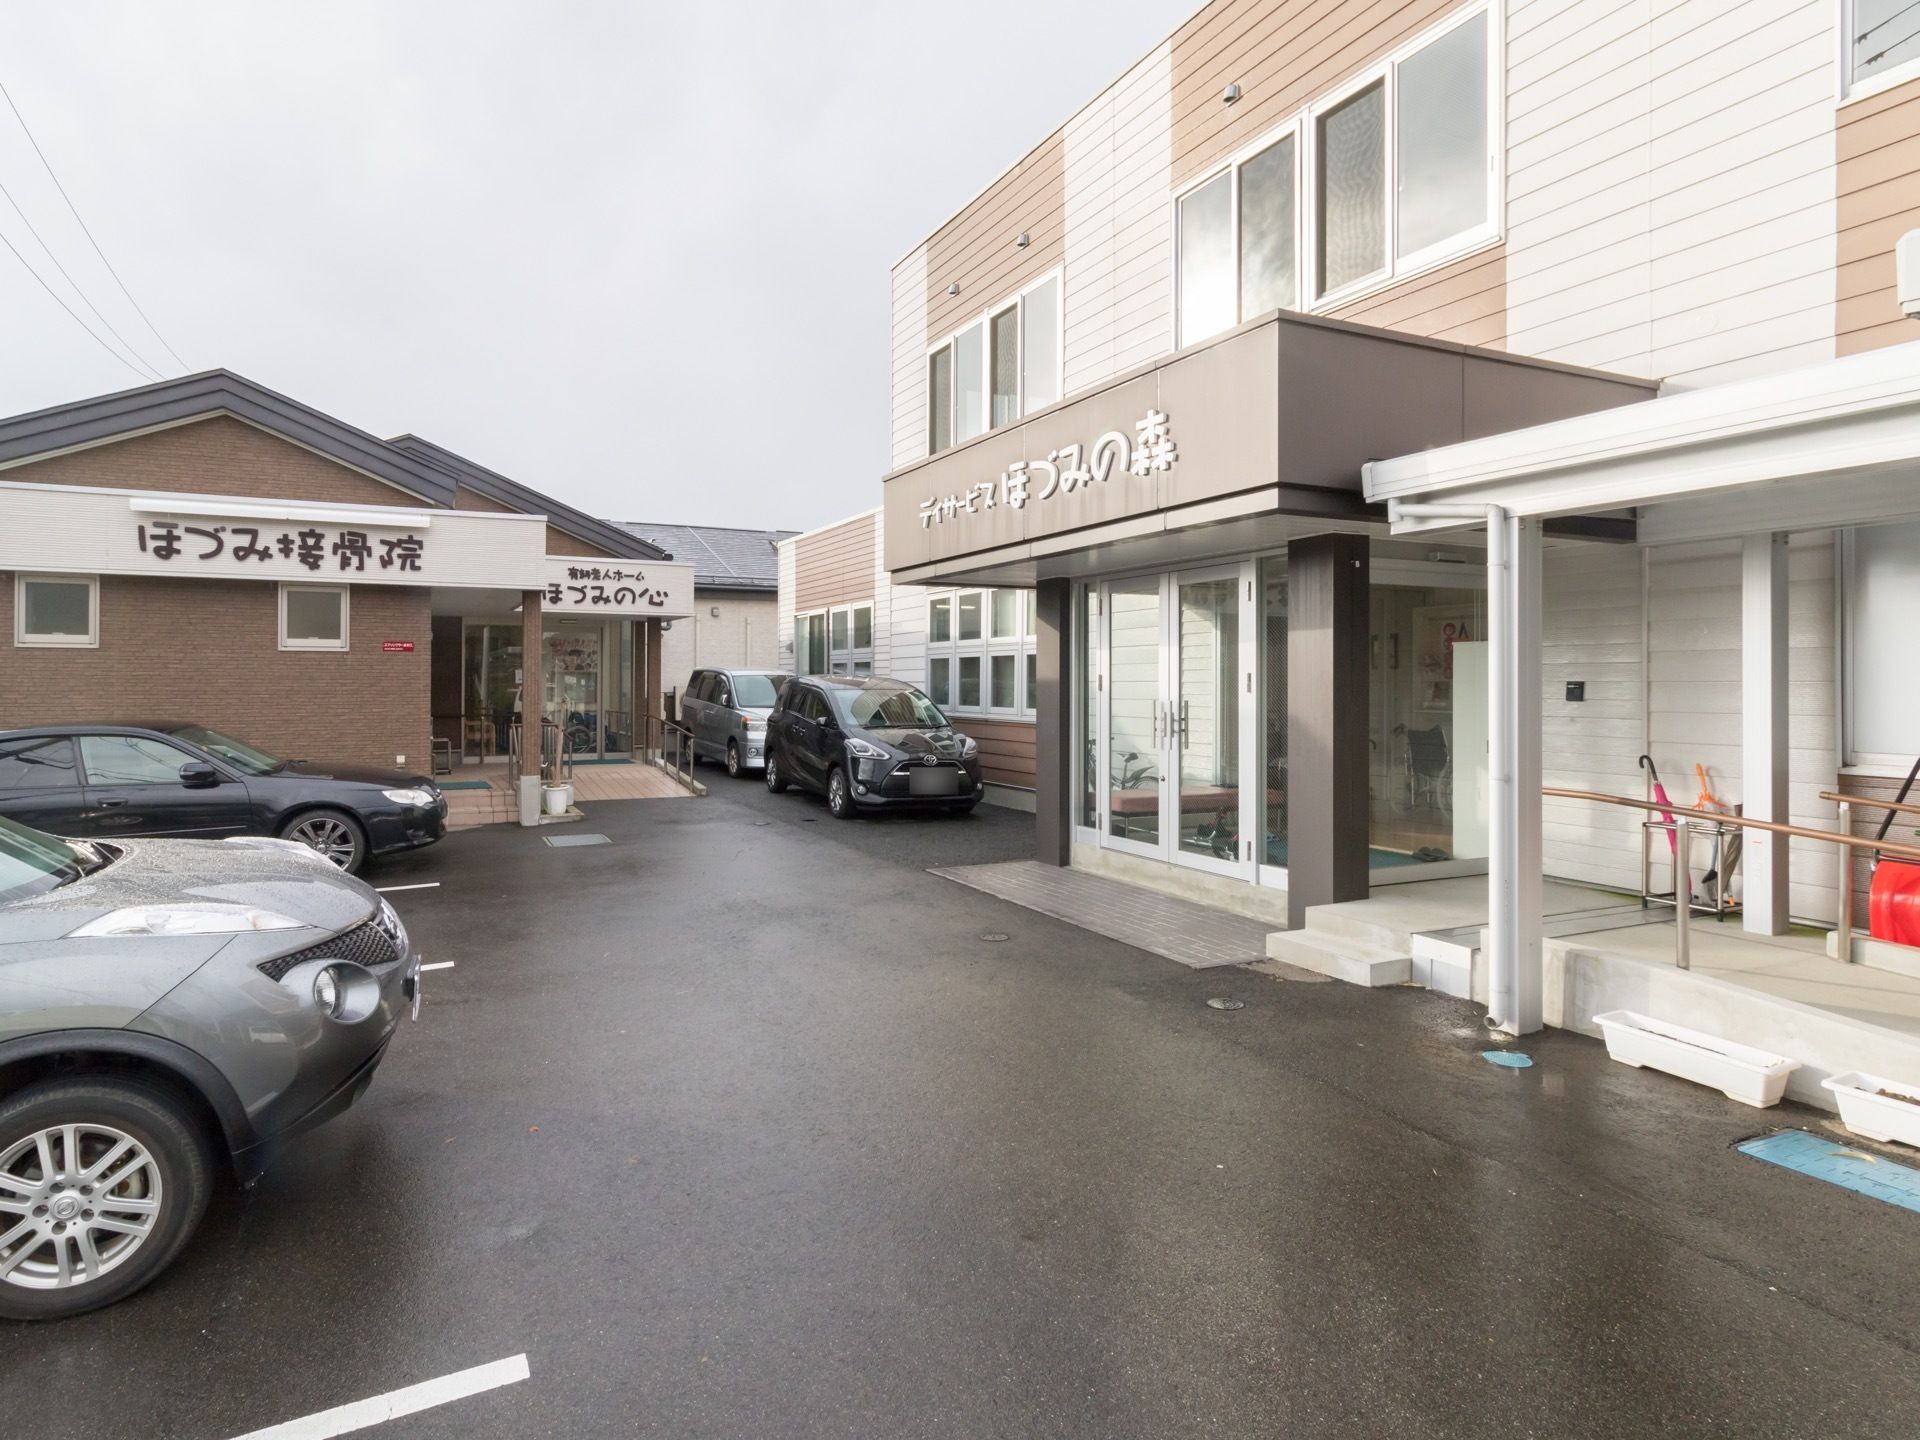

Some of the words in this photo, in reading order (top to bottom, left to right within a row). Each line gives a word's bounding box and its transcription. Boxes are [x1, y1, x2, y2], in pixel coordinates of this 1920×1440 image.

[919, 482, 997, 528] デイサービス
[1002, 409, 1178, 508] ほづみの森
[138, 521, 424, 571] ほづみ接骨院
[567, 566, 645, 581] 有料老人ホーム
[541, 582, 669, 607] ほづみの心
